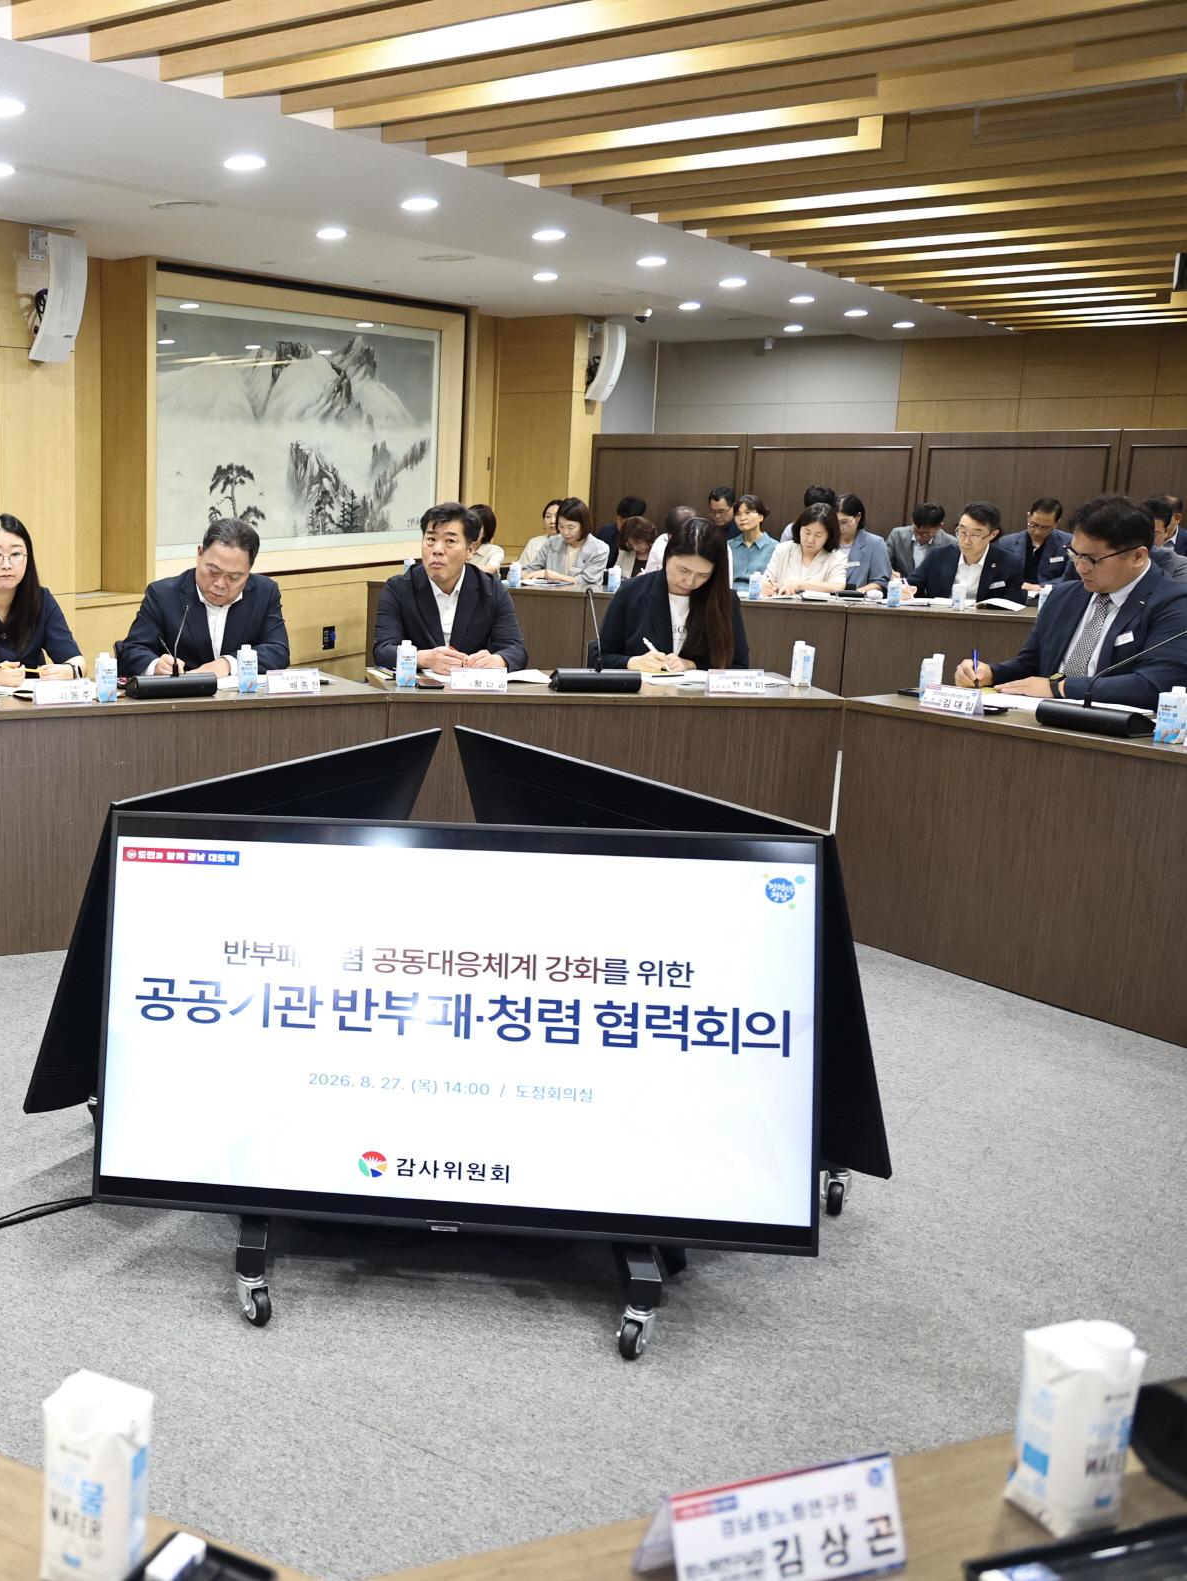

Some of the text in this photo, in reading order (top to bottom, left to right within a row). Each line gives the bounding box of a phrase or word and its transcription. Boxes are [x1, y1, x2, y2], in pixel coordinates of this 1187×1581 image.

[137, 850, 236, 863] 도민과 함께 경남 대도약
[372, 947, 537, 981] 공동대응체계
[545, 955, 630, 986] 강화를
[637, 960, 695, 988] 위한
[135, 977, 790, 1058] 공공기관 반부패·청렴 협력회의
[308, 1073, 355, 1087] 2026.
[360, 1076, 375, 1088] 8.
[381, 1077, 405, 1090] 27.
[411, 1079, 438, 1094] (목)
[443, 1081, 490, 1095] 14:00
[515, 1085, 593, 1103] 도정회의실
[396, 1158, 510, 1184] 감사위원회
[773, 1515, 897, 1578] 김상곤
